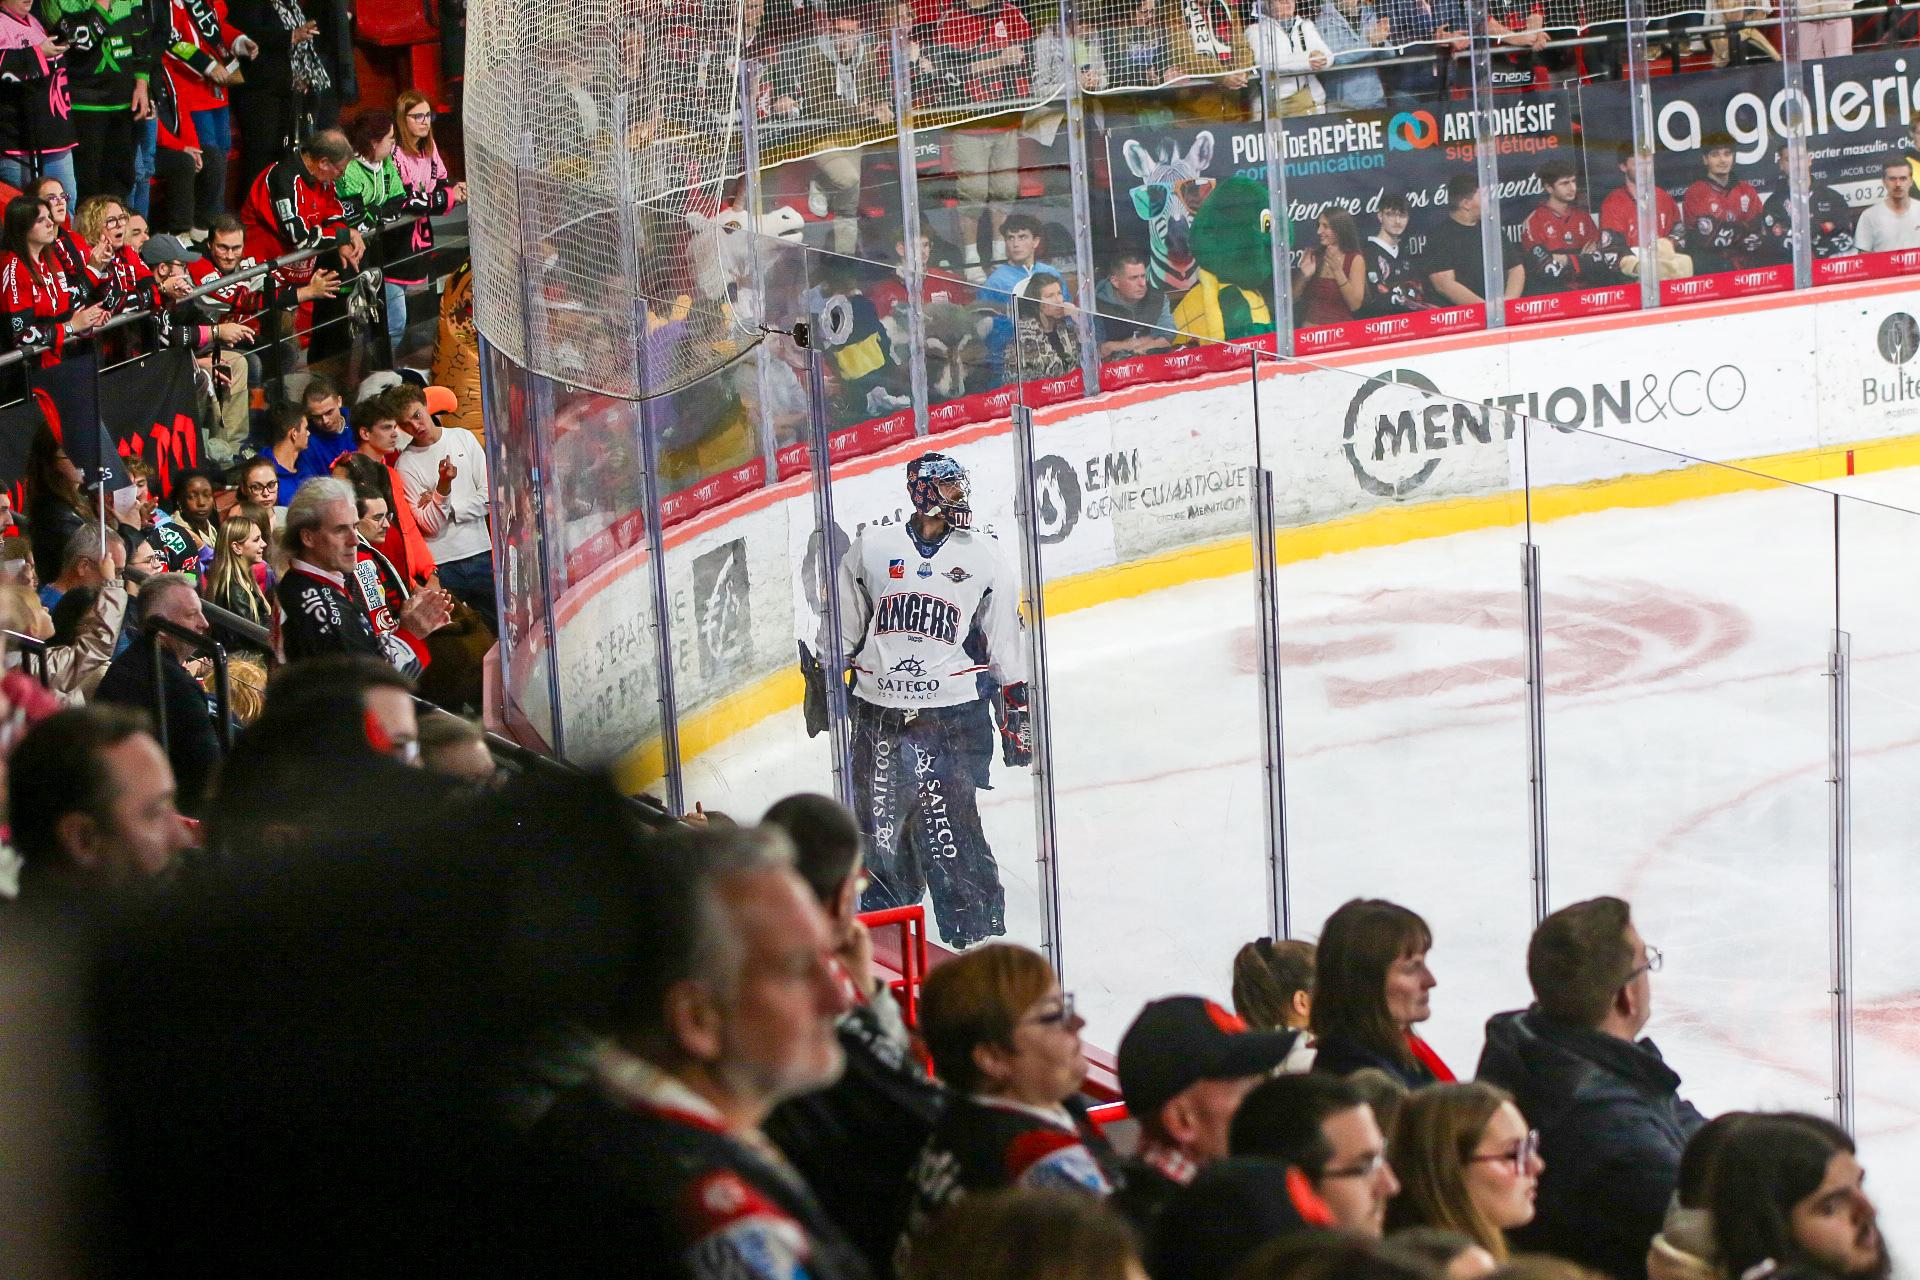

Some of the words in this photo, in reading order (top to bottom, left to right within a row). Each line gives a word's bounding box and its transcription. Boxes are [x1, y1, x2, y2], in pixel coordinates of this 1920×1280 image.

[1724, 58, 1920, 165] galeri
[1843, 140, 1888, 156] masculin
[1821, 258, 1864, 274] somme
[1891, 250, 1920, 266] som
[10, 257, 19, 305] McCORMIC
[1670, 278, 1714, 294] somme
[1734, 270, 1777, 286] somme
[1580, 289, 1625, 305] somme
[1514, 298, 1559, 314] somme
[1430, 308, 1475, 325] somme
[1365, 317, 1409, 334] somme
[1300, 327, 1344, 345] somme
[874, 591, 961, 646] ANGERS
[877, 677, 940, 693] SATECO
[872, 740, 890, 818] SATECO
[918, 781, 942, 861] ASSURANCE
[926, 779, 958, 858] SATECO
